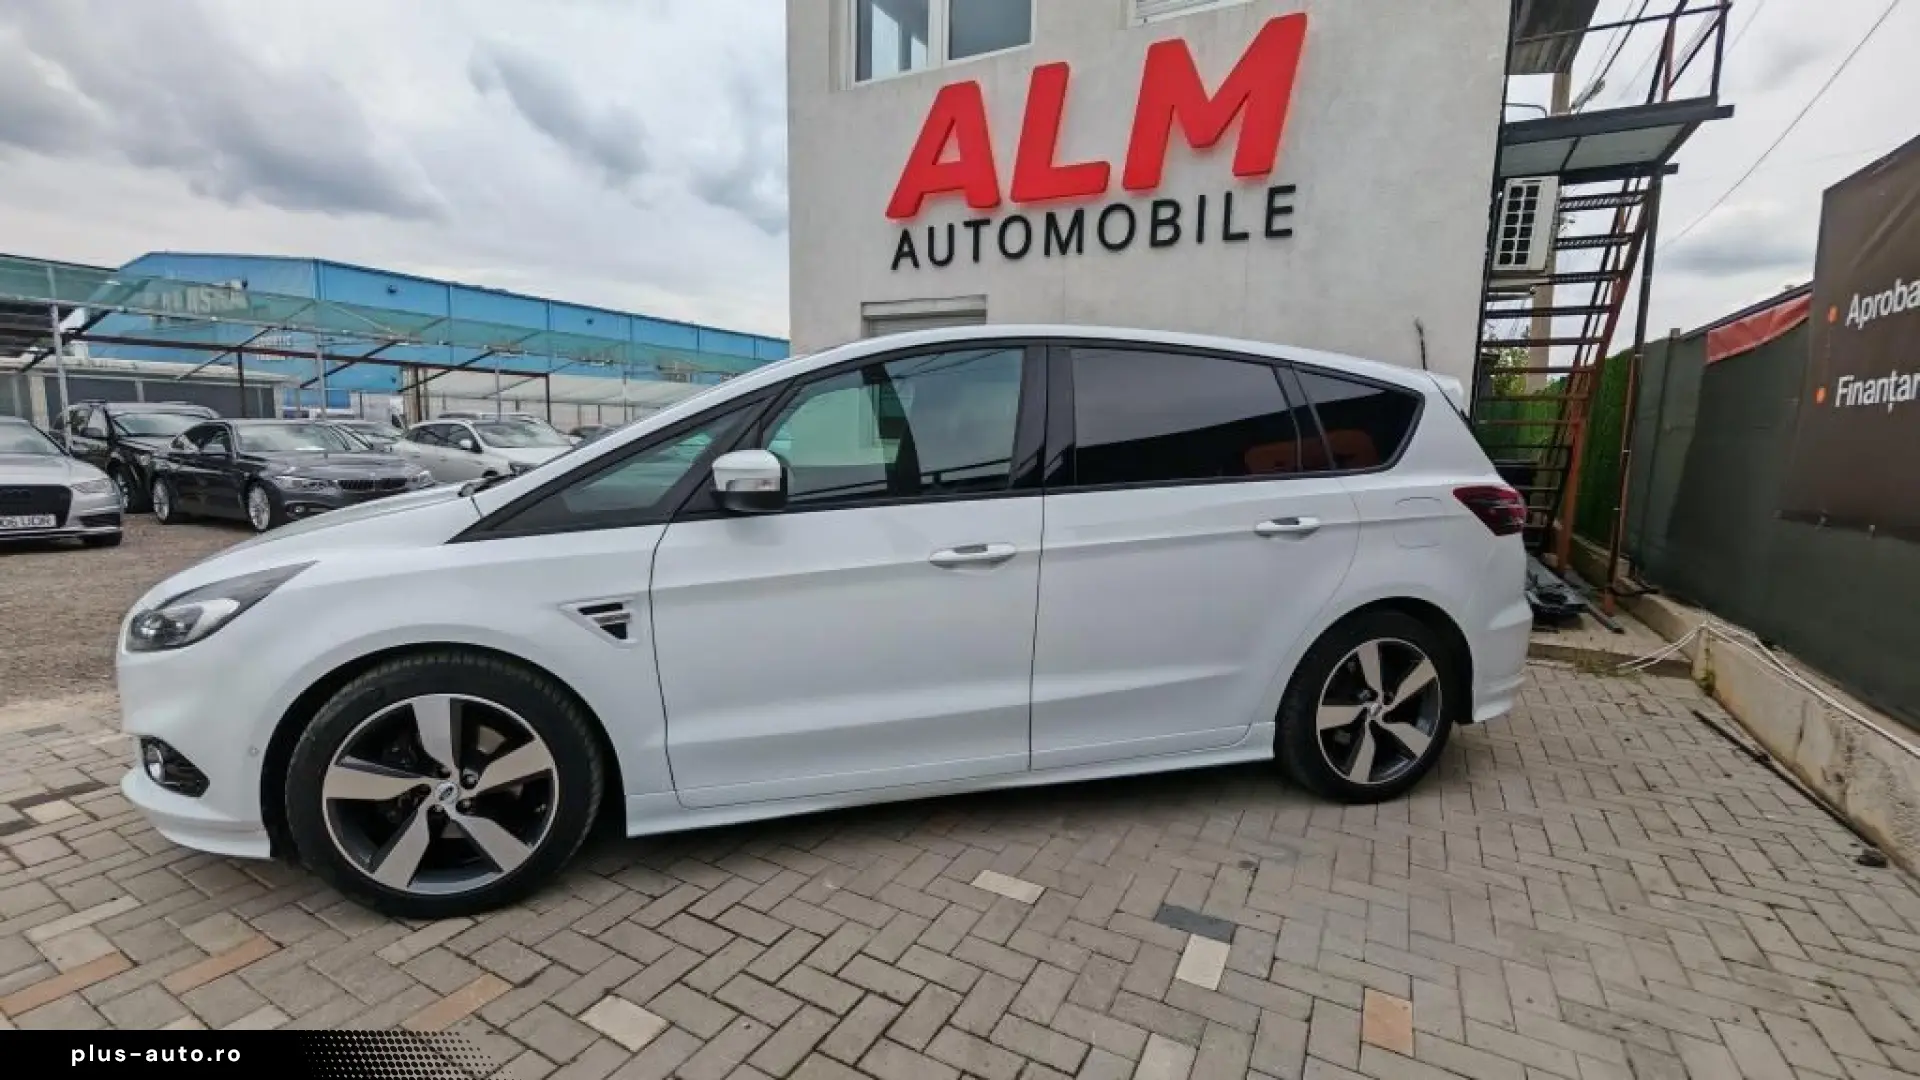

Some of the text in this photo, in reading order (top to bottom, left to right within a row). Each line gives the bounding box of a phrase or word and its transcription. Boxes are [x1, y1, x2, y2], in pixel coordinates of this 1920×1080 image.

[885, 12, 1308, 219] ALM
[890, 183, 1297, 271] AUTOMOBILE
[1845, 278, 1920, 330] Aproba
